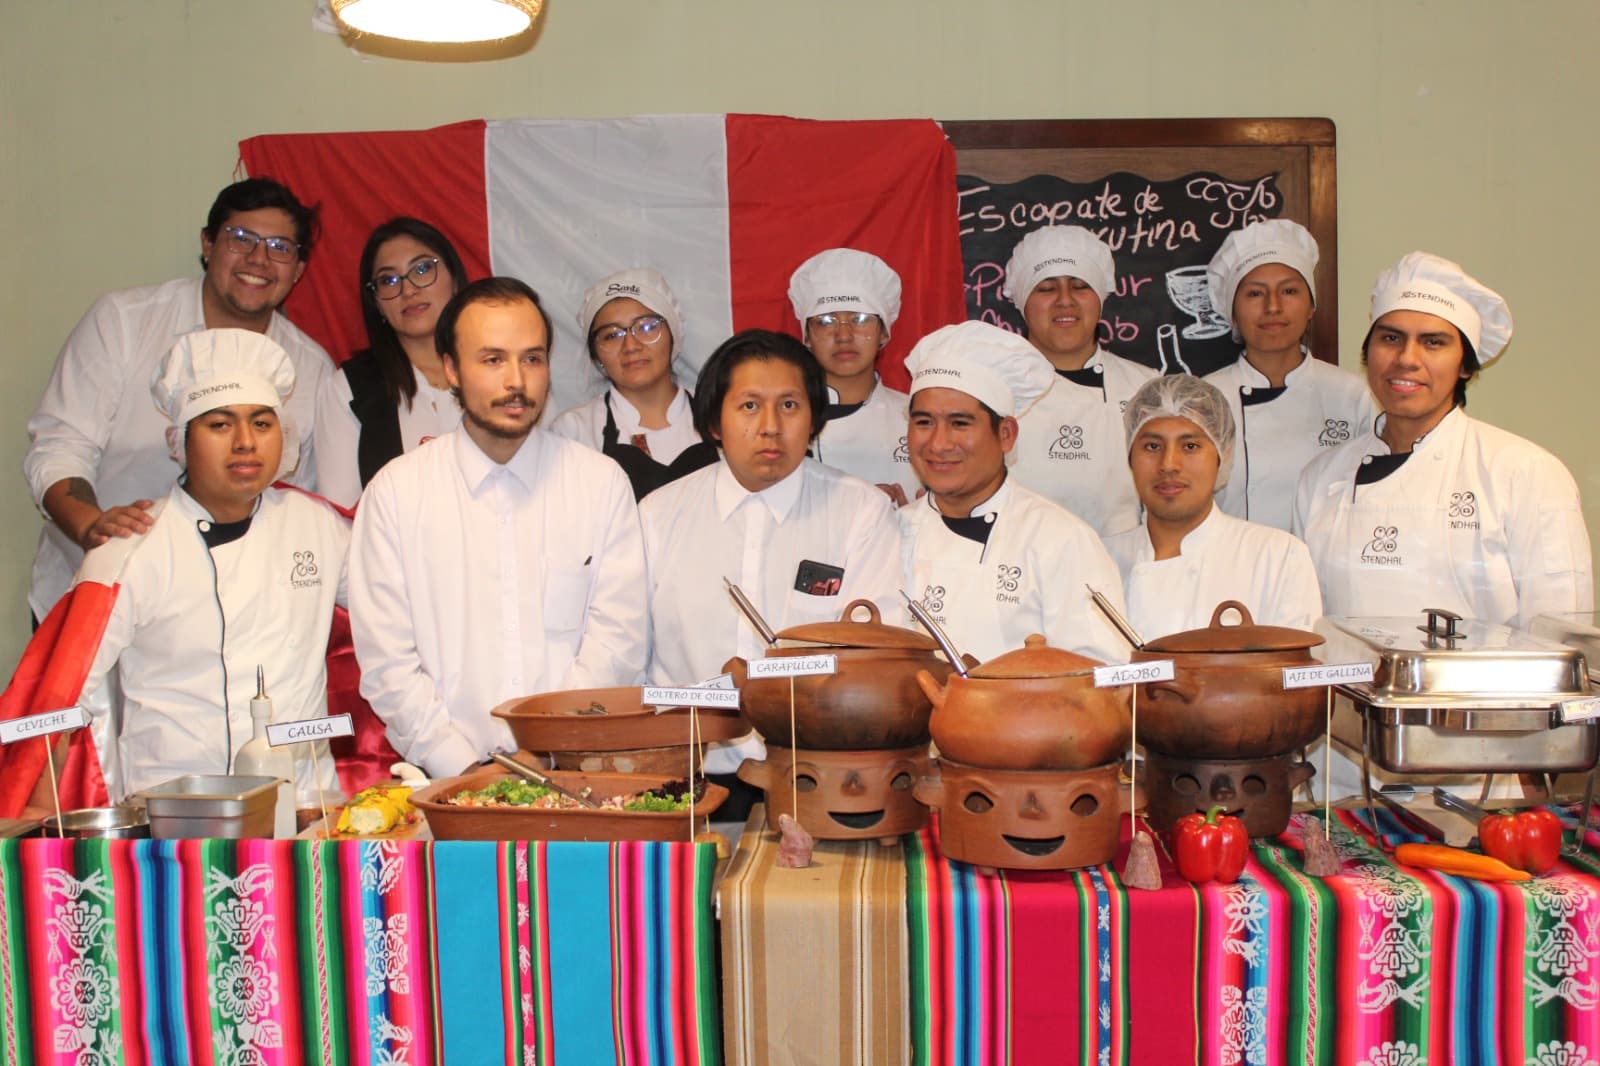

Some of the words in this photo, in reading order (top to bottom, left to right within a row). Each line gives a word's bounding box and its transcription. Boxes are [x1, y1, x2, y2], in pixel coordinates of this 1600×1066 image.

[957, 181, 1127, 236] Escapate
[1134, 184, 1164, 214] de
[825, 295, 862, 304] STENDHAL
[1409, 291, 1456, 311] STENDHAL
[196, 382, 243, 399] STENDHAL
[1048, 451, 1092, 460] STENDHAL
[1360, 555, 1403, 566] STENDHAL
[756, 660, 829, 673] CARAPULCRA
[1310, 670, 1324, 680] DE
[1326, 667, 1371, 679] GALLINA
[1111, 667, 1161, 682] ADOBO
[647, 689, 688, 701] SOLTERO
[690, 692, 704, 700] DE
[705, 692, 737, 702] QUESO
[16, 713, 67, 733] CEVICHE
[288, 723, 333, 738] CAUSA
